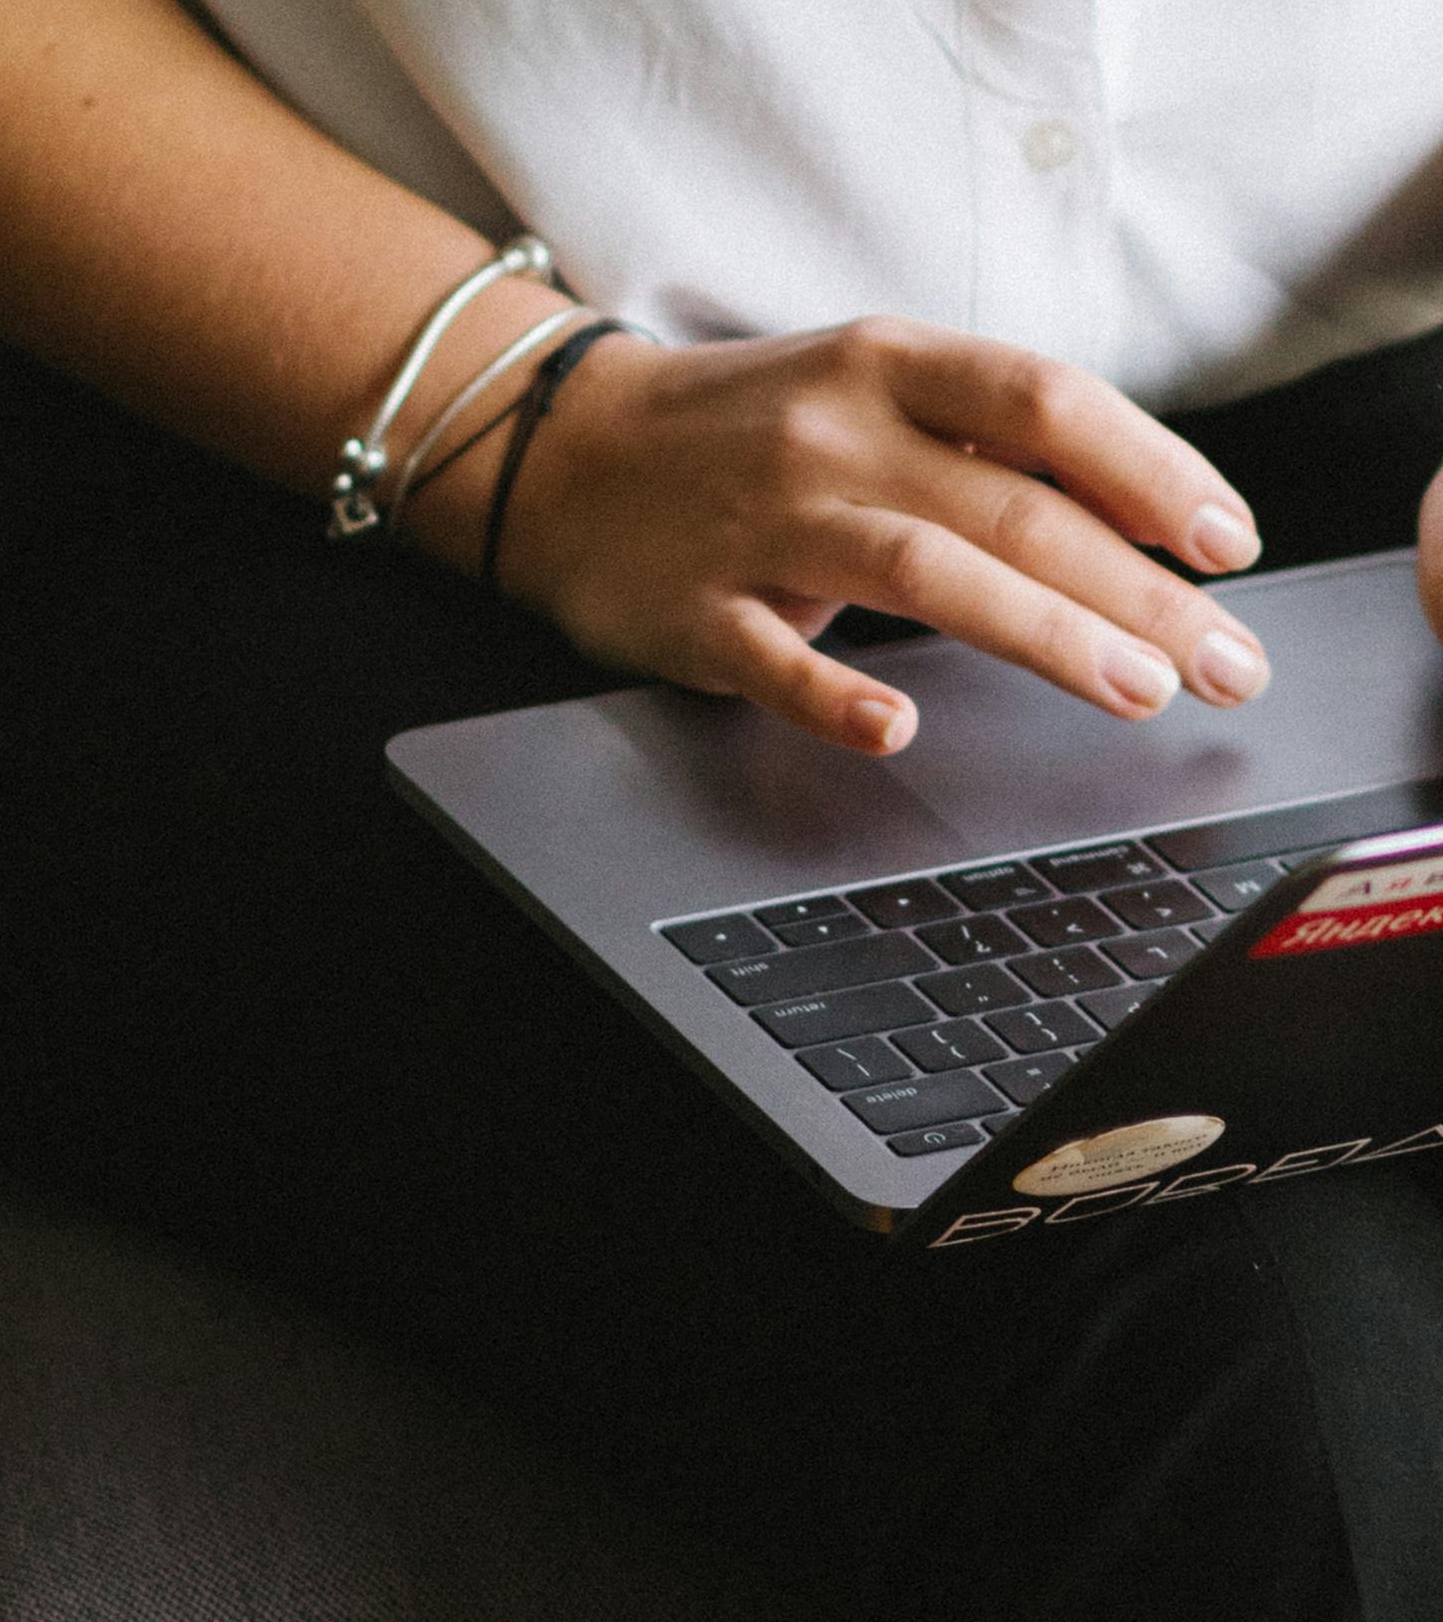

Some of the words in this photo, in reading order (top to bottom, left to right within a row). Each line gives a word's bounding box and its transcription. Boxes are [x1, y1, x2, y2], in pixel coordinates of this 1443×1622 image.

[1337, 878, 1372, 902] А
[1385, 876, 1414, 892] я
[729, 962, 769, 977] shift
[774, 1001, 826, 1018] return
[865, 1086, 918, 1104] delete
